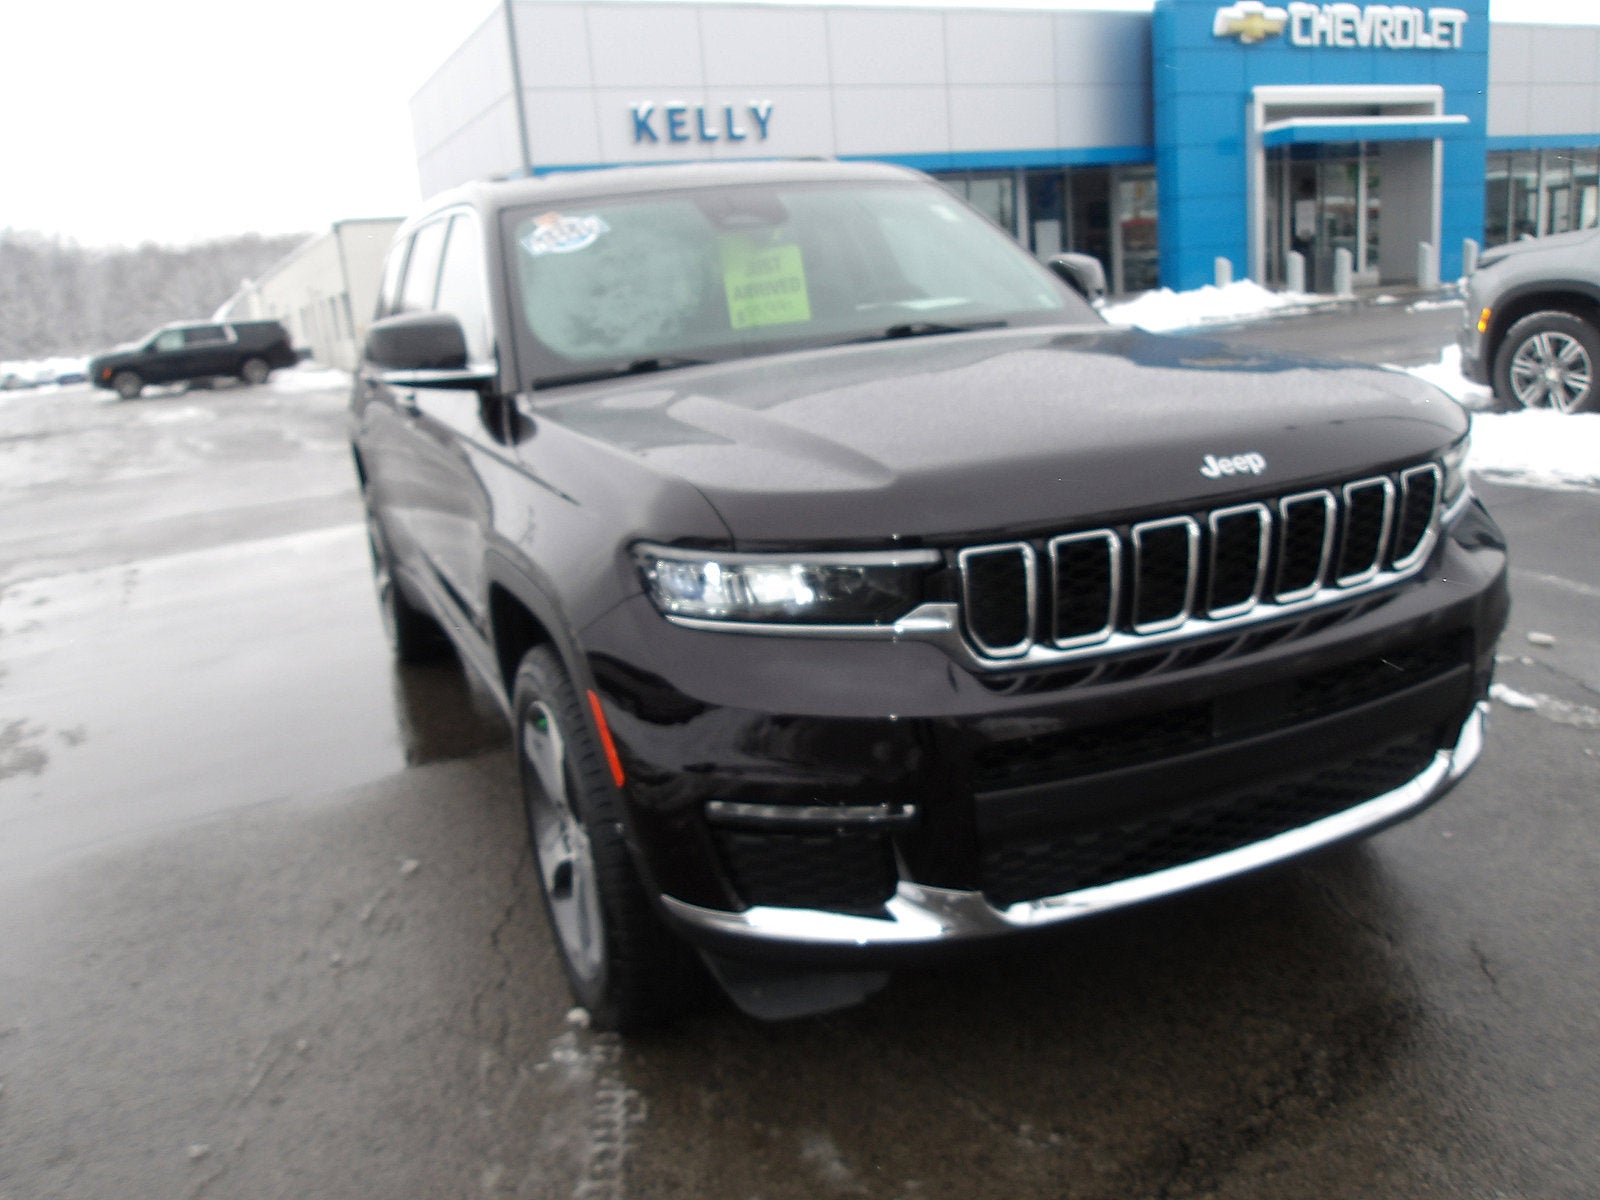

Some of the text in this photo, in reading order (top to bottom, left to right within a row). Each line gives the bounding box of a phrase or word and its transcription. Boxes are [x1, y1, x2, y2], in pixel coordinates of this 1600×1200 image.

[1287, 3, 1468, 49] CHEVROLET
[630, 103, 773, 143] KELLY
[1200, 453, 1266, 478] Jeep
